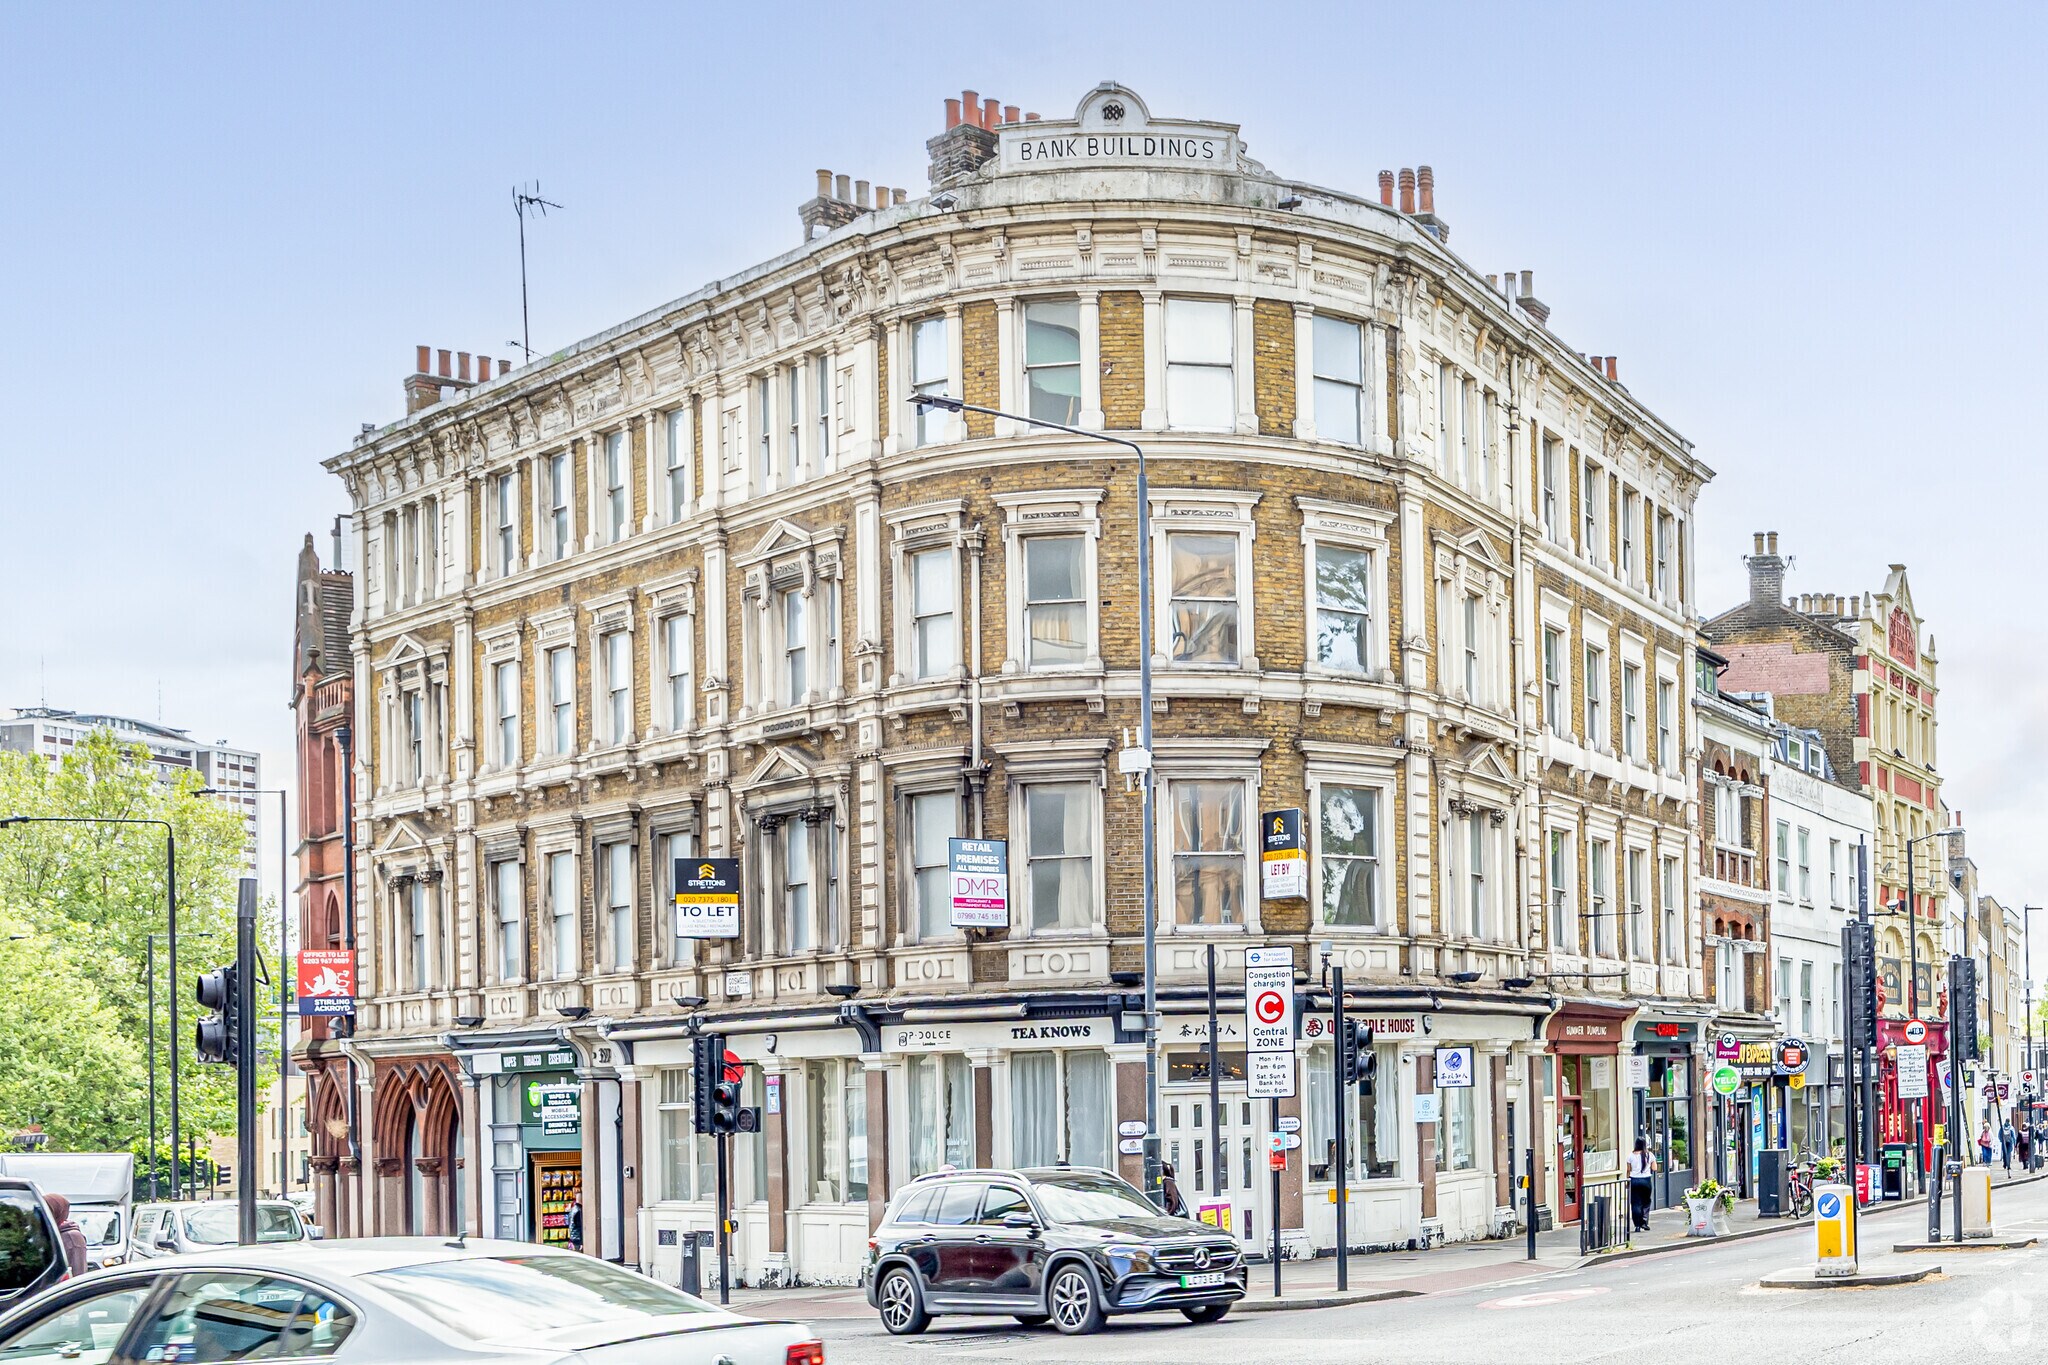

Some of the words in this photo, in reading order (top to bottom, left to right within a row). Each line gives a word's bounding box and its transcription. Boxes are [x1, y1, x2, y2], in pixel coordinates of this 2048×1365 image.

[1102, 104, 1124, 121] 1880
[1021, 138, 1078, 161] BANK
[1088, 137, 1214, 160] BUILDINGS
[962, 842, 992, 852] RETAIL
[956, 854, 1000, 865] PREMISES
[1271, 864, 1280, 876] LET
[1282, 863, 1290, 874] BY
[958, 878, 999, 896] DMR
[680, 906, 702, 917] TO
[707, 906, 735, 916] LET
[1249, 971, 1290, 979] Congestion
[1012, 1026, 1038, 1039] TEA
[1040, 1025, 1091, 1038] KNOWS
[1253, 1027, 1288, 1036] Central
[1388, 1019, 1415, 1033] HOUSE
[1586, 1024, 1607, 1035] DUMPLING
[1256, 1038, 1285, 1046] ZONE
[1786, 1040, 1805, 1051] YOU
[1746, 1043, 1770, 1063] EXPRESS
[503, 1056, 517, 1067] VAPES
[523, 1054, 542, 1066] TOBACCO
[548, 1052, 573, 1065] ESSENTIALS
[1779, 1060, 1807, 1073] EXPRESS
[1715, 1076, 1737, 1084] VELO
